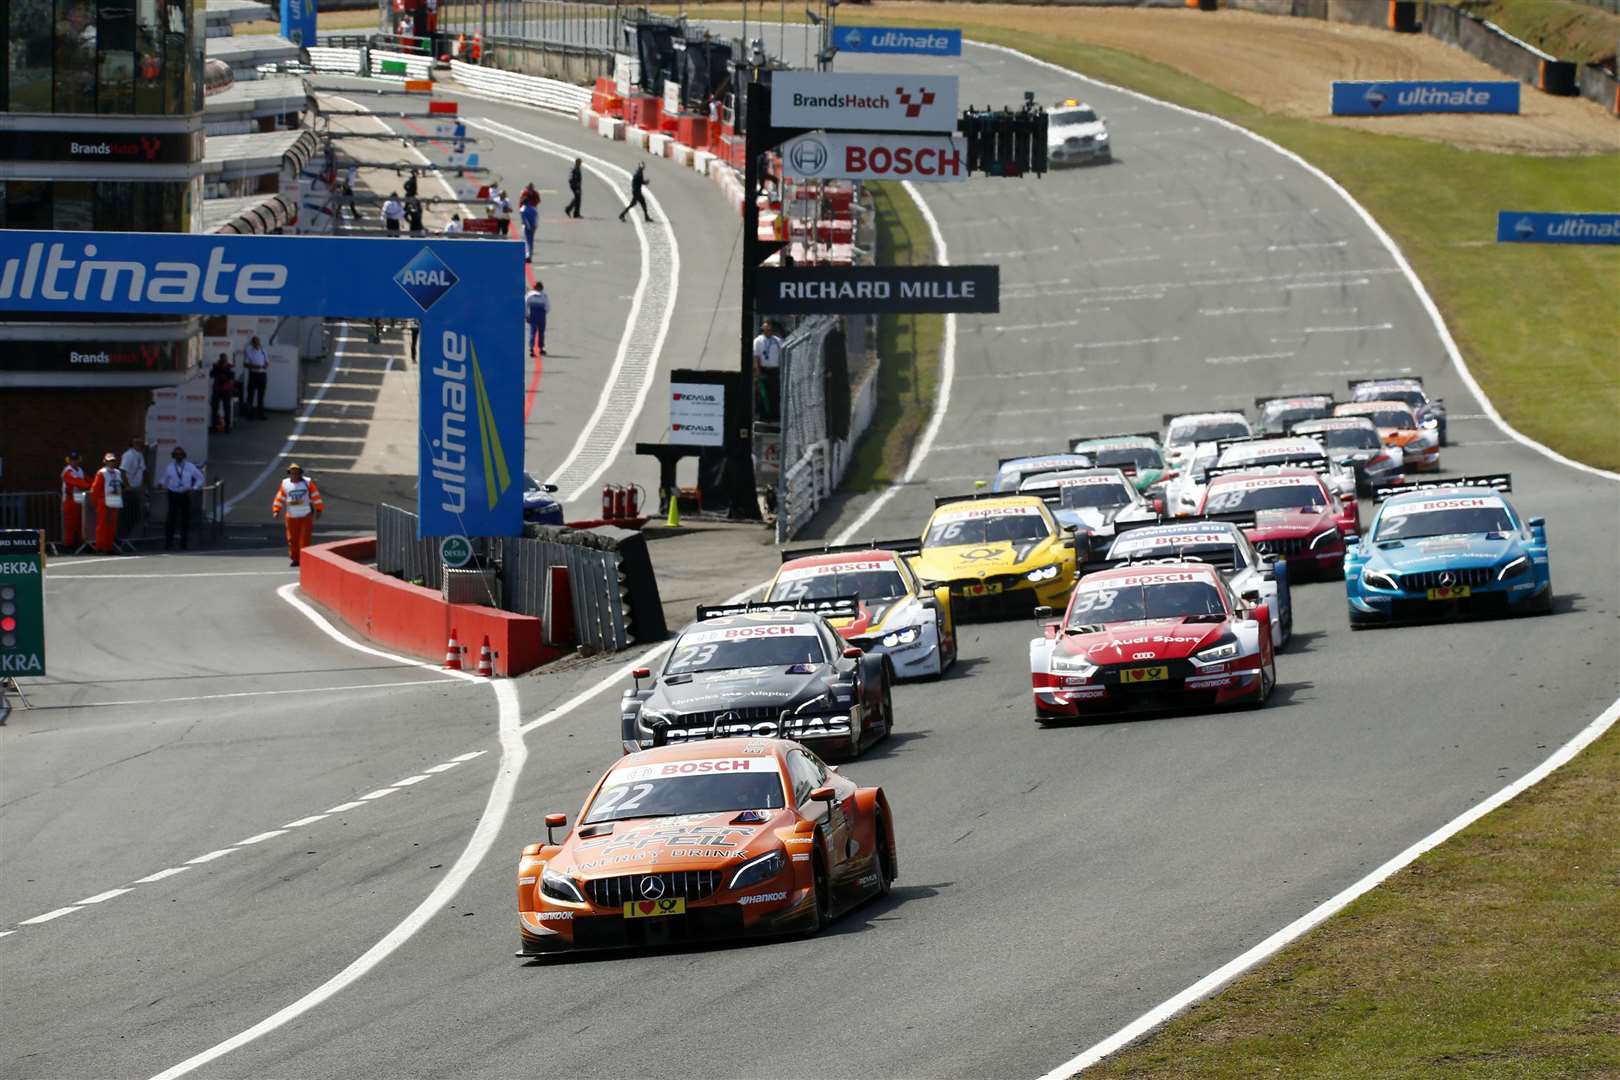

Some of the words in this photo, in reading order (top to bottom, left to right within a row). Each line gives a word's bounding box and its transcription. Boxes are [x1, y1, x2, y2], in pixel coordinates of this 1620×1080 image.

[872, 32, 949, 49] ultimate
[793, 93, 890, 109] BrandsHatch
[1397, 88, 1491, 104] ultimate
[845, 146, 961, 177] BOSCH
[402, 269, 451, 287] ARAL
[779, 281, 891, 299] RICHARD
[898, 281, 976, 298] MILLE
[431, 330, 467, 515] ultimate
[1246, 478, 1301, 488] BOSCH
[969, 507, 1027, 518] BOSCH
[1424, 499, 1485, 510] BOSCH
[932, 519, 965, 542] 16
[1378, 516, 1409, 537] 2
[1155, 535, 1221, 545] BOSCH
[818, 562, 881, 574] BOSCH
[1125, 574, 1193, 585] BOSCH
[725, 626, 795, 639] BOSCH
[1110, 637, 1148, 648] Audi
[1152, 635, 1201, 644] Sport
[0, 653, 42, 672] KRA
[671, 644, 721, 669] 23
[661, 760, 750, 776] BOSCH
[593, 783, 654, 815] 22
[671, 850, 748, 860] DRINK
